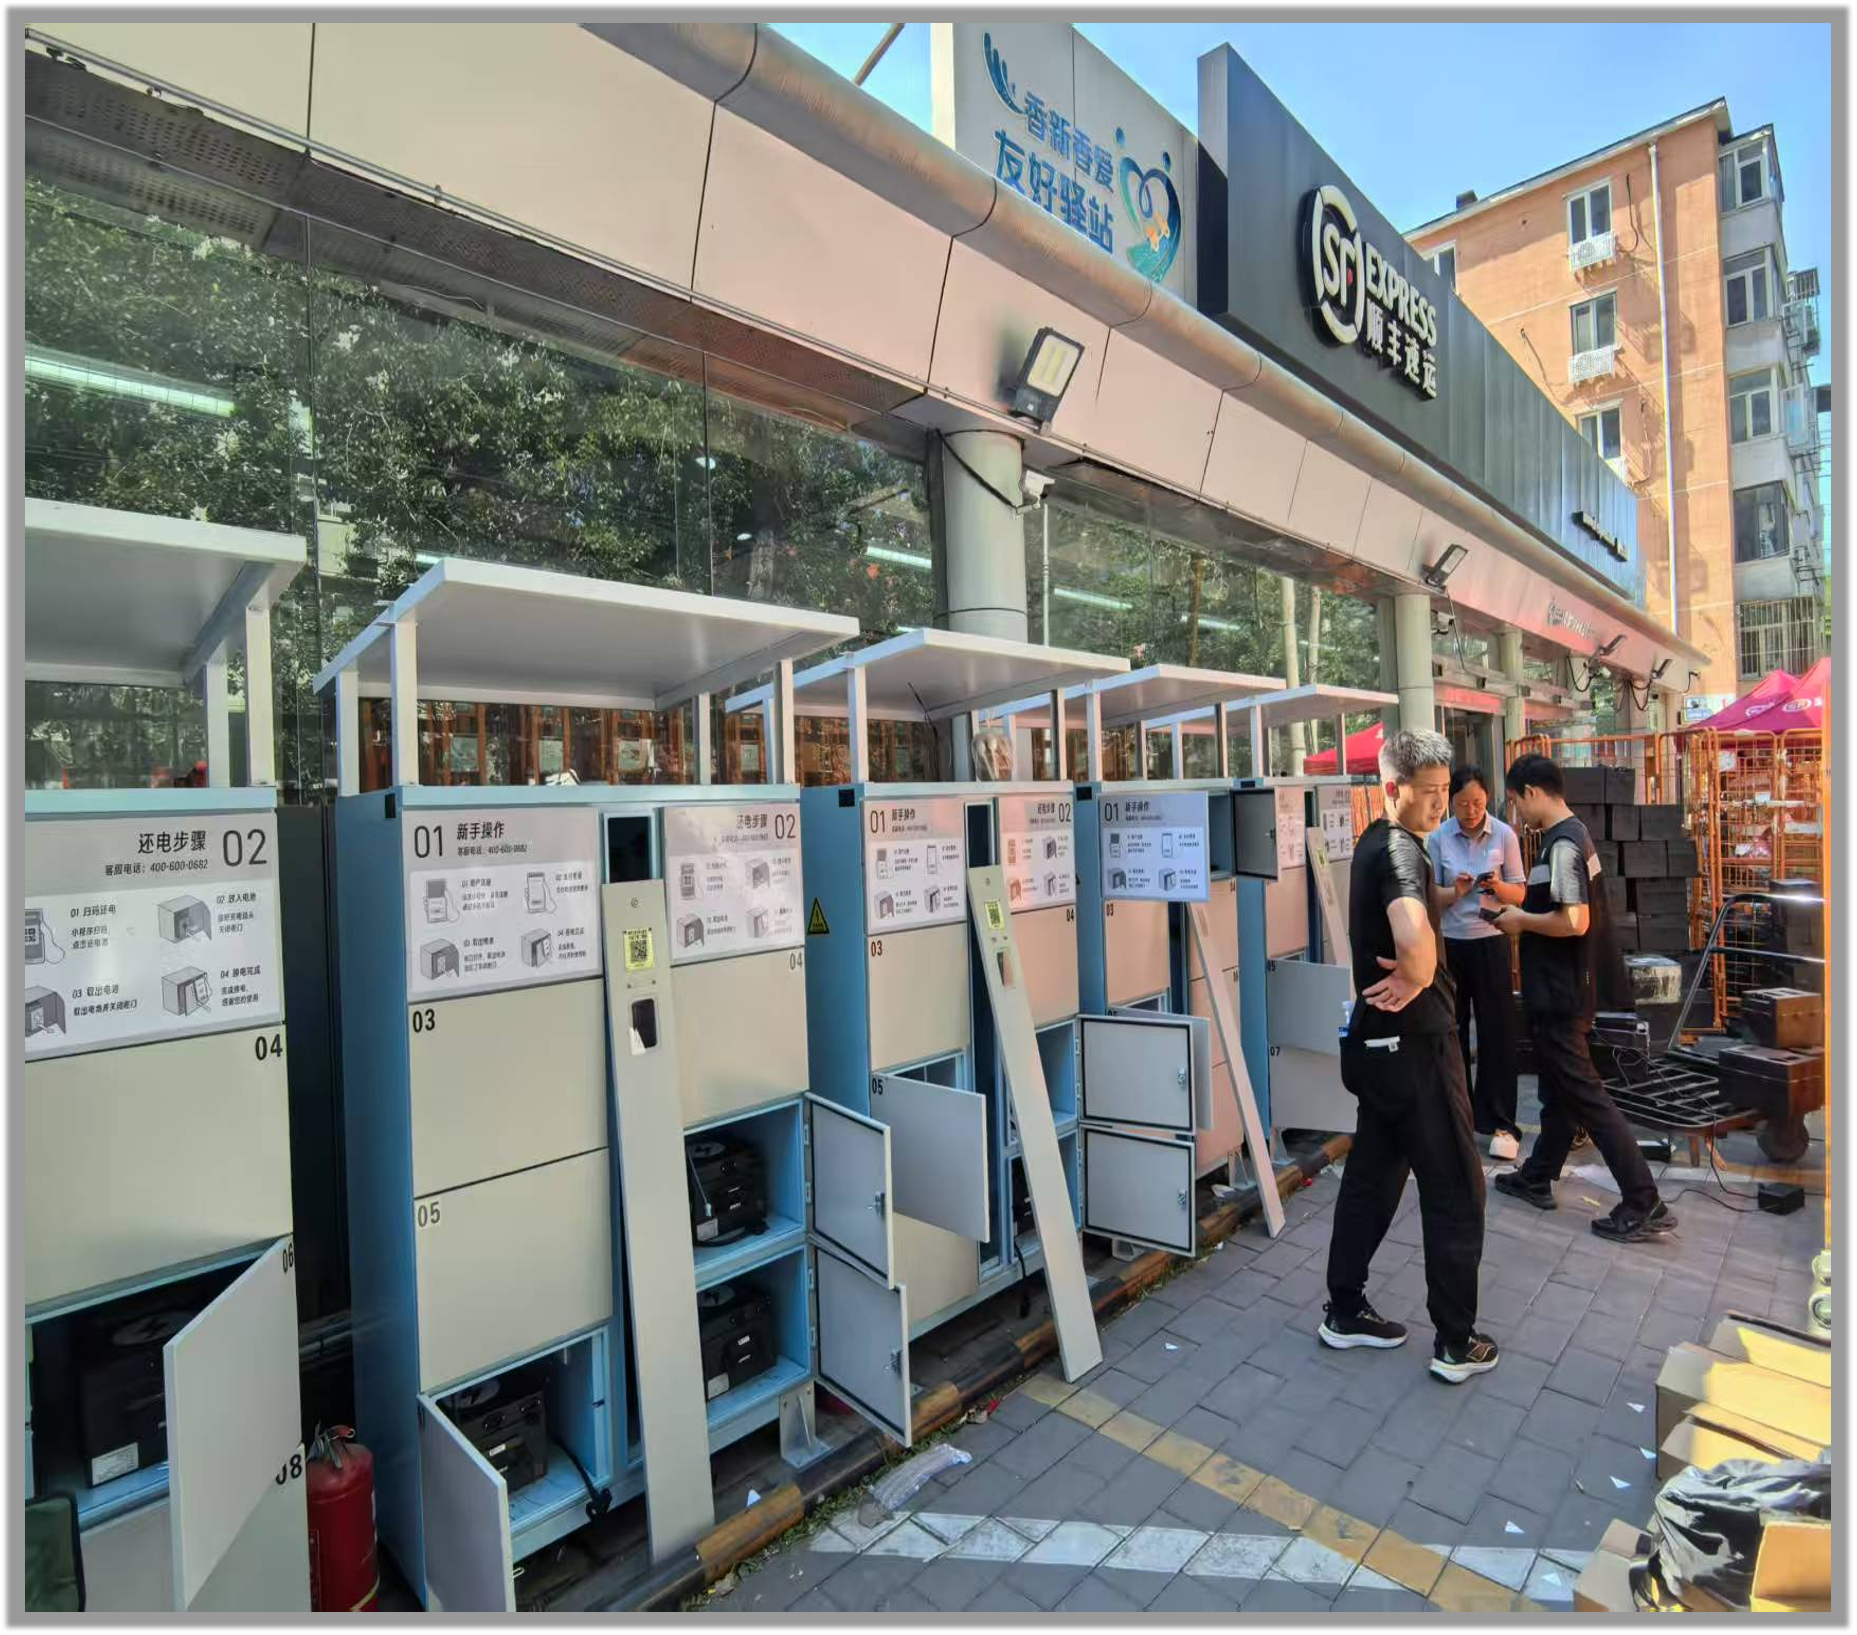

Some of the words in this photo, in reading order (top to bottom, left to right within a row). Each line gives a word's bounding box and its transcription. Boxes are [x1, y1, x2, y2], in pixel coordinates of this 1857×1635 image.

[994, 129, 1113, 254] 友好驿站
[1365, 242, 1437, 348] EXPRESS
[1366, 298, 1437, 399] 顺丰速运
[870, 810, 886, 833] 01
[1058, 802, 1072, 823] 02
[1104, 802, 1119, 822] 01
[456, 821, 505, 840] 新手操作
[775, 814, 796, 839] 02
[137, 830, 206, 854] 还电步骤
[222, 828, 268, 867] 02
[414, 825, 444, 858] 01
[789, 952, 803, 970] 04
[870, 940, 883, 957] 03
[413, 1008, 436, 1033] 03
[255, 1034, 283, 1061] 04
[871, 1078, 883, 1096] 05
[417, 1201, 441, 1227] 05
[282, 1243, 294, 1274] 06
